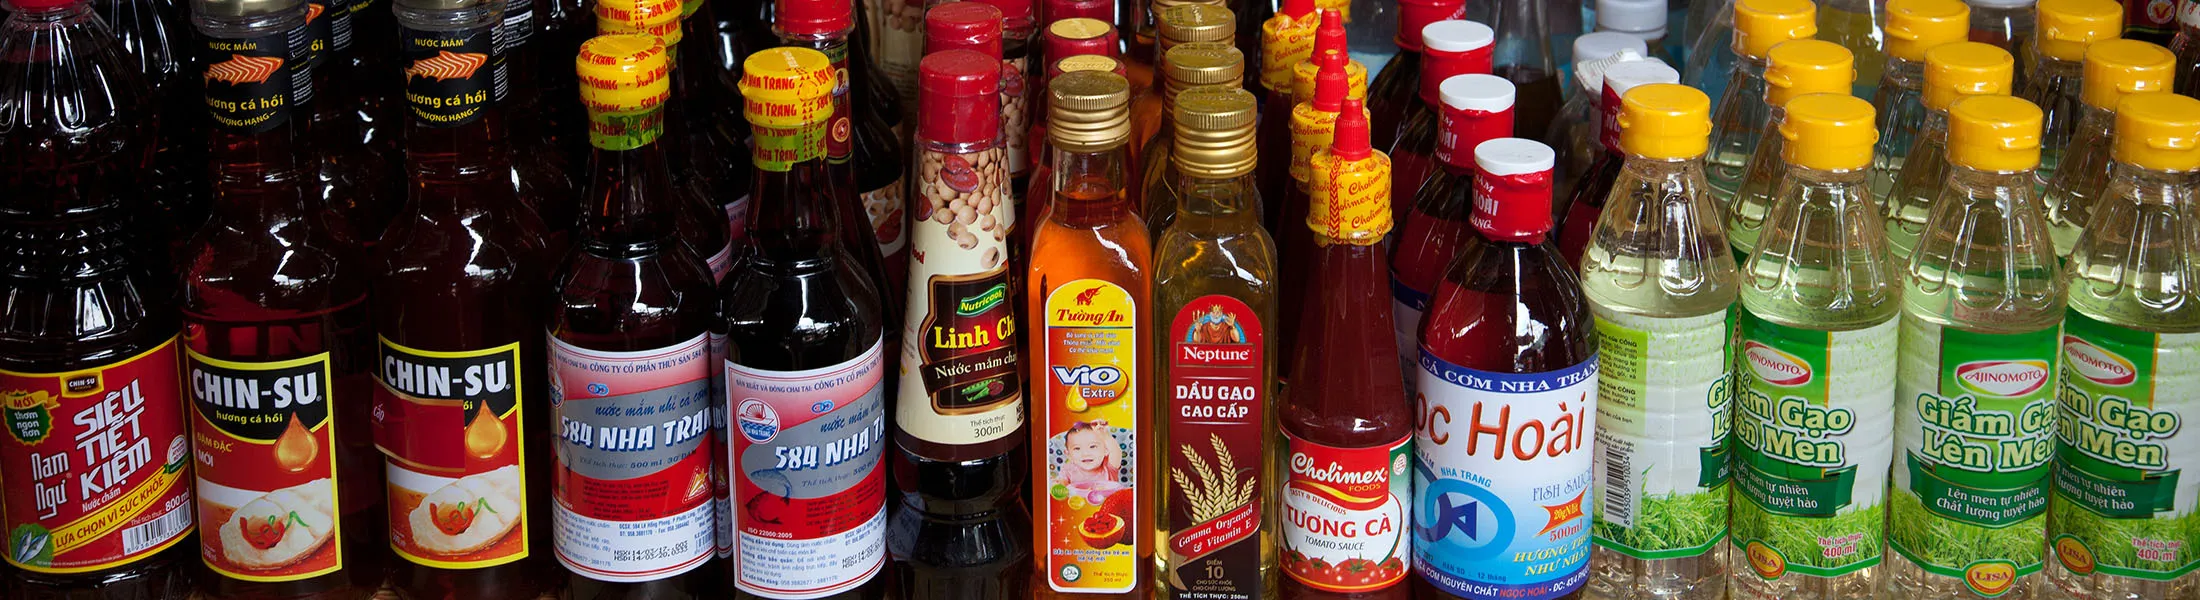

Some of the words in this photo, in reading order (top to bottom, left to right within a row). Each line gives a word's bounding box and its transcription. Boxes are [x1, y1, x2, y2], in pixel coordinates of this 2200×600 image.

[763, 75, 795, 90] TRANG
[240, 97, 257, 110] cá
[261, 93, 284, 109] hồi
[445, 90, 462, 106] cá
[465, 89, 486, 105] hồi
[765, 101, 797, 117] TRANG
[774, 147, 799, 162] TRANG
[1348, 170, 1385, 195] Cholimex
[1352, 203, 1386, 229] Cholimex
[961, 290, 1003, 312] Nutricook
[934, 325, 989, 349] Linh
[1184, 346, 1249, 362] Neptune
[1747, 349, 1799, 375] AJINOMOTO
[2066, 346, 2125, 375] AJINOMOTO
[589, 362, 610, 373] CÔNG
[611, 365, 622, 373] TY
[636, 359, 656, 373] PHẦN
[934, 366, 971, 379] Nước
[974, 357, 1002, 372] mắm
[1422, 357, 1439, 376] CÁ
[1445, 371, 1492, 390] CƠM
[1500, 380, 1551, 391] NHA
[385, 355, 507, 398] CHIN-SU
[814, 380, 835, 391] CÔNG
[836, 377, 845, 387] TY
[1965, 369, 2042, 384] AJINOMOTO
[192, 368, 318, 410] CHIN-SU
[1082, 387, 1115, 398] Extra
[1176, 381, 1213, 400] DẦU
[1217, 386, 1255, 401] GẠO
[73, 379, 145, 441] SIÊU
[595, 403, 621, 417] nước
[625, 398, 655, 417] mắm
[679, 392, 691, 406] cá
[1181, 405, 1213, 418] CAO
[1217, 402, 1249, 418] CẤP
[17, 420, 39, 430] ngon
[216, 410, 247, 425] hương
[250, 412, 262, 424] cá
[264, 412, 284, 424] hồi
[820, 416, 846, 433] nước
[1781, 399, 1850, 437] Gạo
[1917, 394, 2010, 436] Giấm
[2100, 398, 2176, 441] Gạo
[561, 415, 594, 448] 584
[600, 425, 656, 451] NHA
[974, 422, 1004, 438] 300ml
[1467, 391, 1586, 461] Hoài
[76, 406, 145, 467] TIẾT
[1765, 426, 1840, 463] Men
[2080, 422, 2163, 468] Men
[776, 445, 818, 470] 584
[825, 428, 869, 466] NHA
[1922, 427, 1989, 468] Lên
[31, 452, 69, 481] Nam
[630, 461, 649, 470] 500
[651, 459, 662, 468] ml
[1291, 452, 1387, 484] Cholimex
[1348, 483, 1381, 492] FOODS
[1441, 467, 1457, 478] NHA
[1461, 470, 1492, 488] TRANG
[1532, 485, 1561, 502] FISH
[1766, 481, 1777, 494] tự
[1779, 482, 1809, 496] nhiên
[1947, 487, 1968, 501] Lên
[1971, 494, 1997, 506] men
[2001, 493, 2013, 508] tự
[2014, 486, 2040, 504] nhiên
[2094, 483, 2126, 498] nhiên
[35, 478, 68, 520] Ngư
[82, 500, 101, 513] Nước
[101, 487, 121, 503] chấm
[165, 496, 181, 512] 800
[1312, 496, 1347, 515] DELICIOUS
[1768, 494, 1795, 509] tuyệt
[1797, 495, 1818, 508] hảo
[2084, 490, 2109, 510] tuyệt
[2111, 497, 2135, 510] hảo
[55, 530, 75, 548] LỰA
[77, 519, 106, 538] CHỌN
[107, 508, 118, 525] VÌ
[120, 497, 139, 517] SỨC
[140, 475, 164, 502] KHỎE
[1286, 503, 1356, 538] TƯƠNG
[1365, 513, 1391, 537] CÀ
[1965, 503, 2001, 521] lượng
[2003, 503, 2027, 518] tuyệt
[748, 527, 758, 535] ISO
[1178, 526, 1212, 548] Gamma
[1215, 504, 1253, 530] Oryzanol
[1193, 542, 1202, 553] &
[1207, 527, 1241, 548] Vitamin
[1245, 518, 1252, 529] E
[1550, 520, 1583, 542] 500ml
[1305, 535, 1336, 550] TOMATO
[1338, 542, 1364, 550] SAUCE
[1823, 547, 1842, 557] 400
[1844, 543, 1857, 555] ml
[1513, 544, 1568, 563] HƯƠNG
[2138, 549, 2159, 560] 400
[2162, 549, 2176, 561] ml
[1205, 567, 1224, 580] 10
[1477, 571, 1485, 579] 12
[1524, 562, 1560, 577] NHƯ
[1976, 571, 2008, 582] LISA
[1193, 591, 1208, 599] TÍCH
[1440, 575, 1472, 592] NGUYÊN
[1474, 584, 1498, 597] CHẤT
[1499, 590, 1526, 599] NGỌC
[1553, 581, 1565, 592] ĐC:
